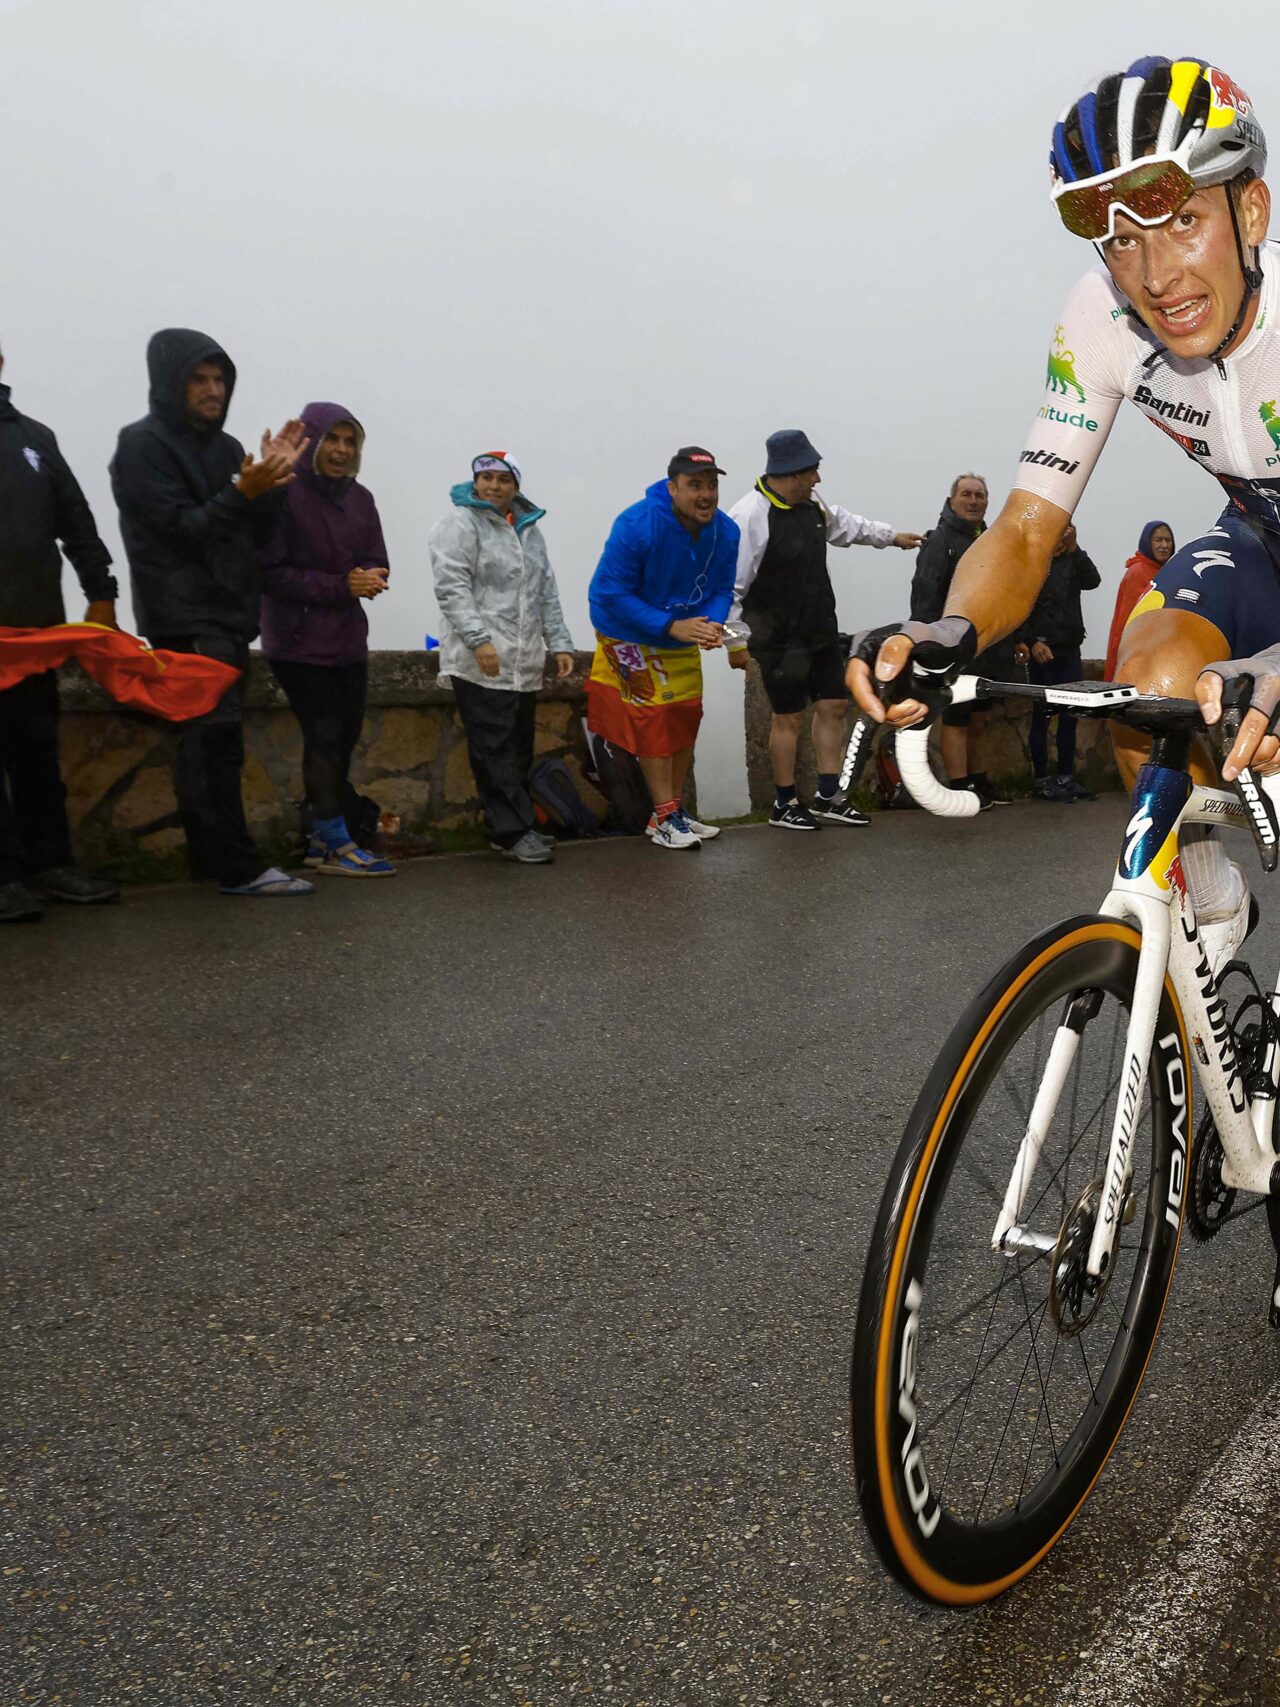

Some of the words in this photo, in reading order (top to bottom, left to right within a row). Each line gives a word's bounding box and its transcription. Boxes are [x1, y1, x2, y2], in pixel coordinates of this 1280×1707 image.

[1133, 384, 1211, 428] Santini
[1193, 441, 1207, 454] 24
[838, 720, 866, 791] SRAM
[1238, 767, 1276, 845] SRAM
[1105, 1053, 1142, 1224] SPECIALIZED
[1159, 1032, 1186, 1231] roval
[899, 1276, 941, 1539] roval
